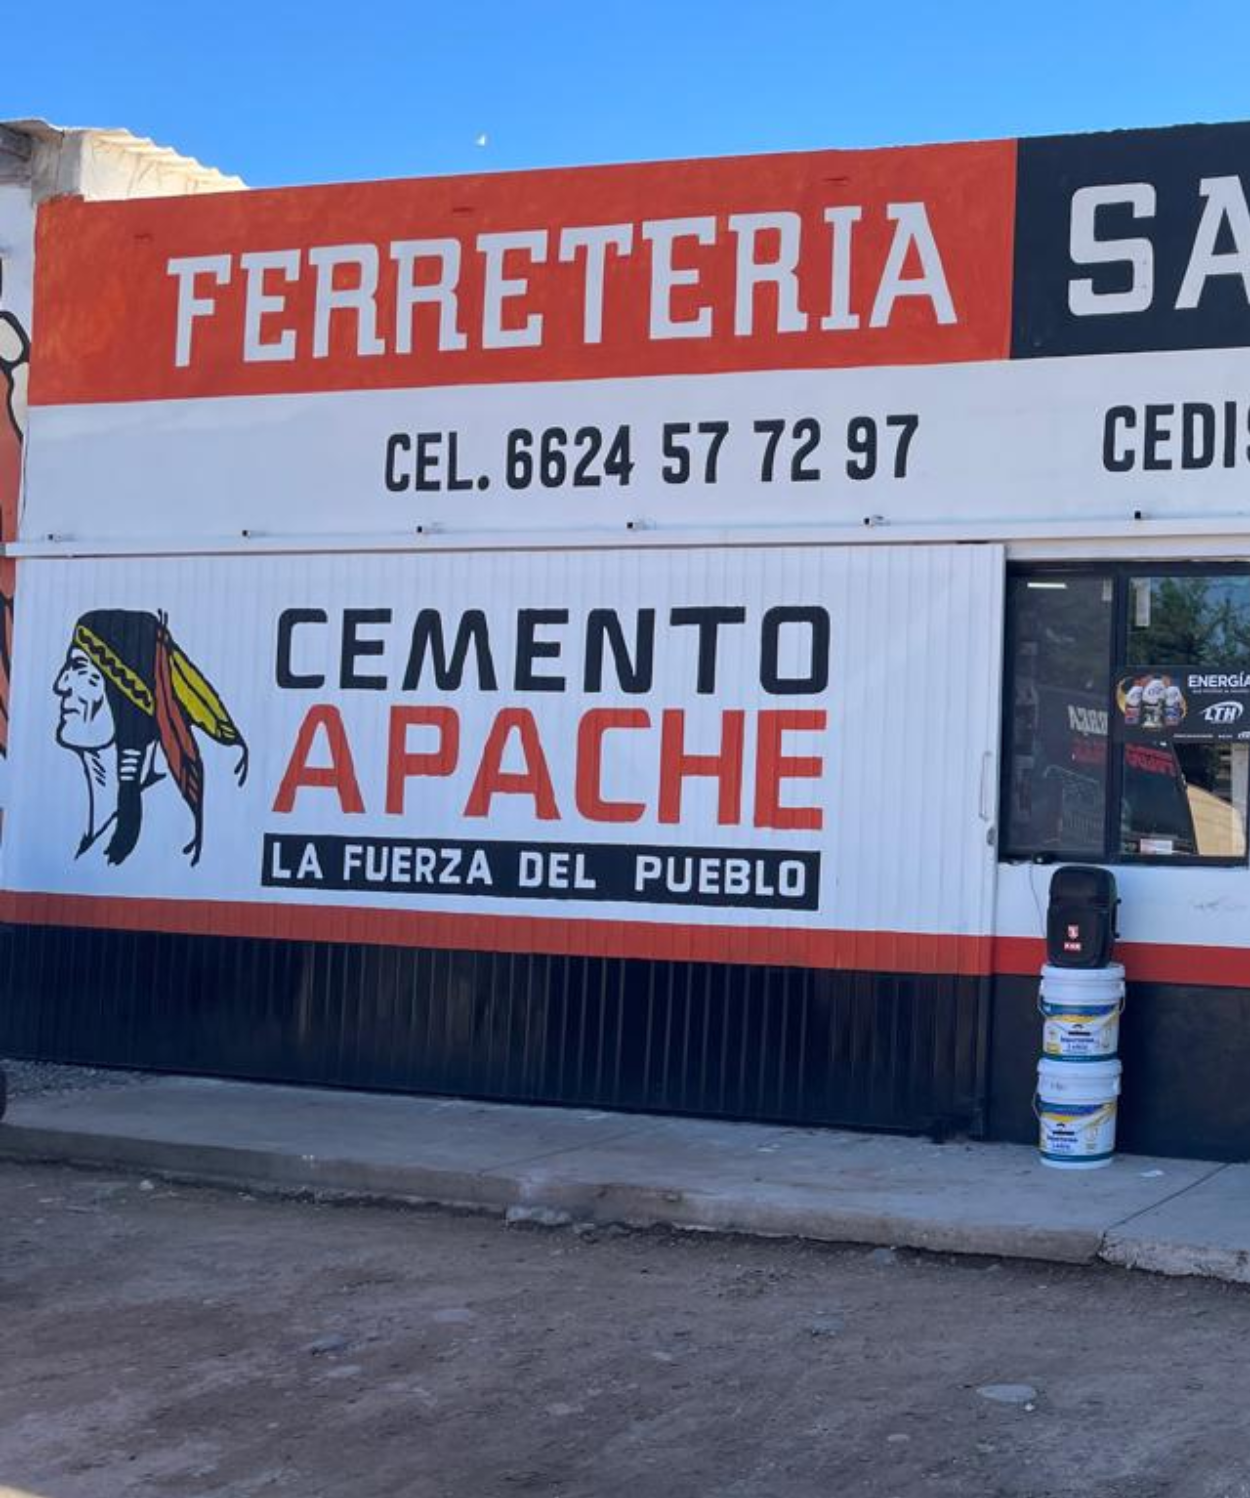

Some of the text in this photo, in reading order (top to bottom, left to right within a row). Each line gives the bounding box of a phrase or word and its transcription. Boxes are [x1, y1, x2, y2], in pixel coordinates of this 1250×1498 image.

[167, 201, 958, 368] FERRETERIA
[386, 415, 919, 492] CEL. 6624 57 72 97
[276, 605, 830, 695] CEMENTO
[272, 704, 826, 829] APACHE
[273, 843, 806, 897] LA FUERZA DEL PUEBLO
